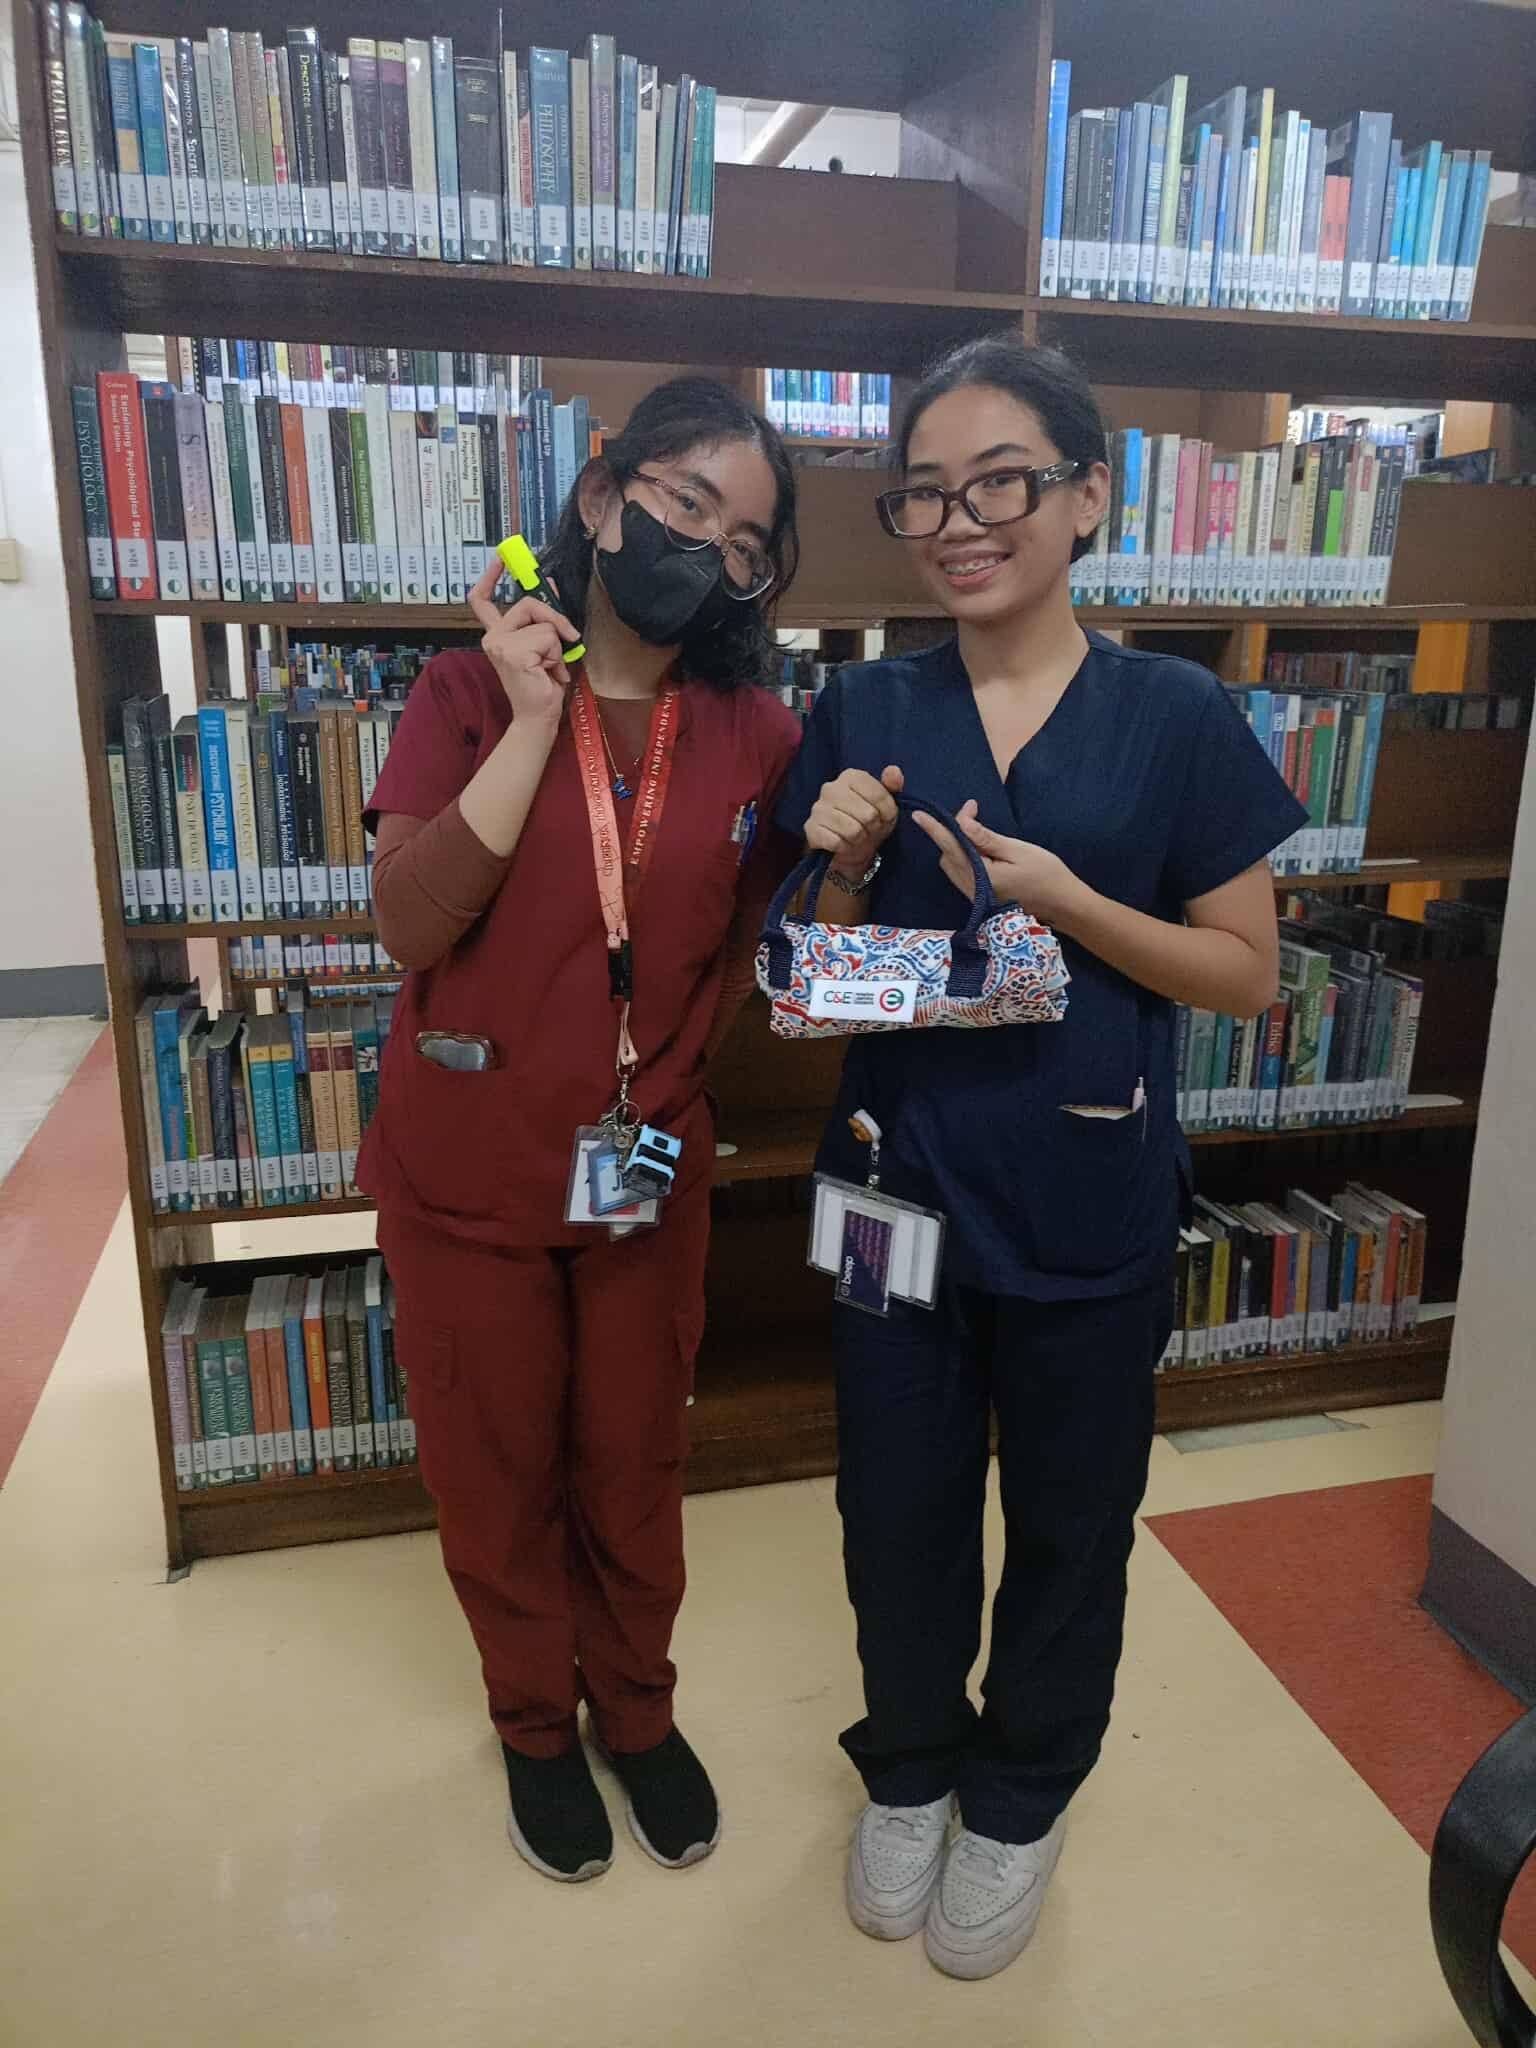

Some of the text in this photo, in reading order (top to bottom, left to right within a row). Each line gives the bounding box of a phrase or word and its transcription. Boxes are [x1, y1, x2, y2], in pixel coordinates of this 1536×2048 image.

[50, 60, 68, 121] SPECIAL
[181, 79, 193, 125] JOHNSON
[299, 55, 312, 108] Descartes
[599, 90, 610, 137] Archetypes
[538, 103, 556, 193] PHILOSOPHY
[110, 394, 121, 453] Second Edition
[120, 395, 133, 447] Explaining
[541, 399, 551, 457] Measuring Up
[77, 420, 97, 514] PSYCHOLOGY
[126, 450, 140, 518] Psychological
[423, 462, 434, 509] Psychology
[461, 440, 470, 481] Psychology
[471, 466, 479, 495] Methods
[363, 738, 372, 787] Psychology
[138, 766, 155, 846] PSYCHOLOGY
[209, 744, 228, 846] DISCOVERING PSYCHOLOGY
[236, 763, 252, 860] PSYCHOLOGY
[185, 793, 200, 865] PSYCHOLOGY
[630, 780, 659, 866] EMPOWERING
[823, 990, 853, 1004] C&E
[1267, 1021, 1282, 1055] Ethics
[1405, 1015, 1416, 1053] Ethics
[841, 1255, 856, 1285] beep
